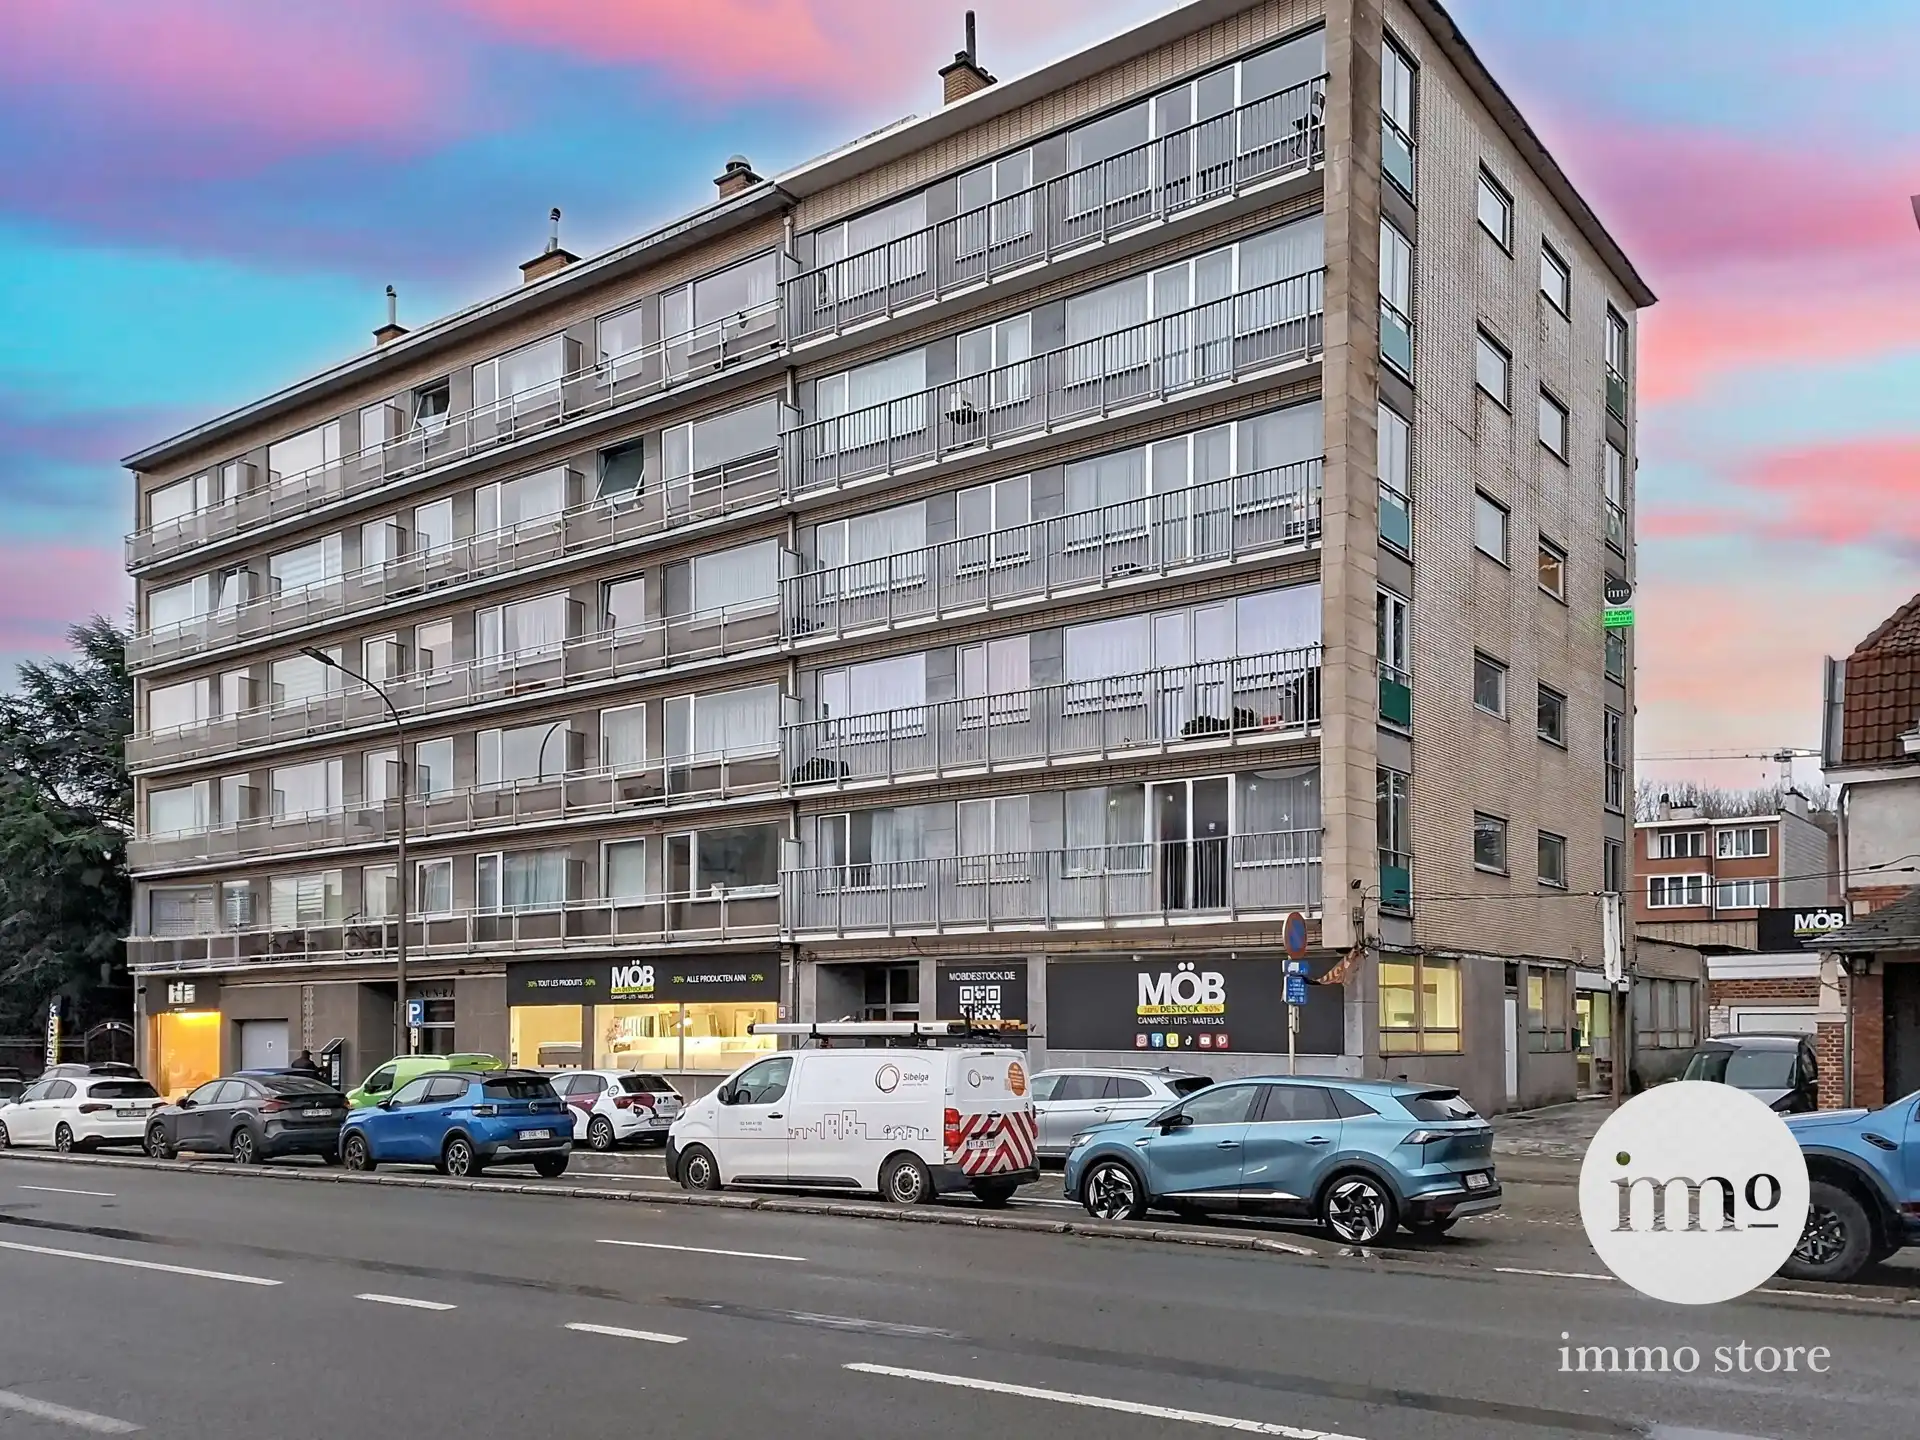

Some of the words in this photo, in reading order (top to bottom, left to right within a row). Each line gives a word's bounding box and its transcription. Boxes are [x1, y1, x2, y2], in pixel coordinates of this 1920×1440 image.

[1794, 909, 1844, 929] MÖB
[611, 959, 655, 988] MÖB
[686, 975, 699, 983] ALLE
[700, 974, 733, 982] PRODUCTEN
[537, 979, 550, 987] TOUT
[550, 979, 559, 987] LES
[559, 978, 583, 986] PRODUITS
[1137, 962, 1226, 1006] MÖB
[408, 1003, 421, 1023] P
[1160, 1005, 1200, 1013] DESTOCK
[1173, 1016, 1188, 1025] LITS
[1192, 1016, 1225, 1025] MATELAS
[903, 1073, 929, 1083] Sibelga
